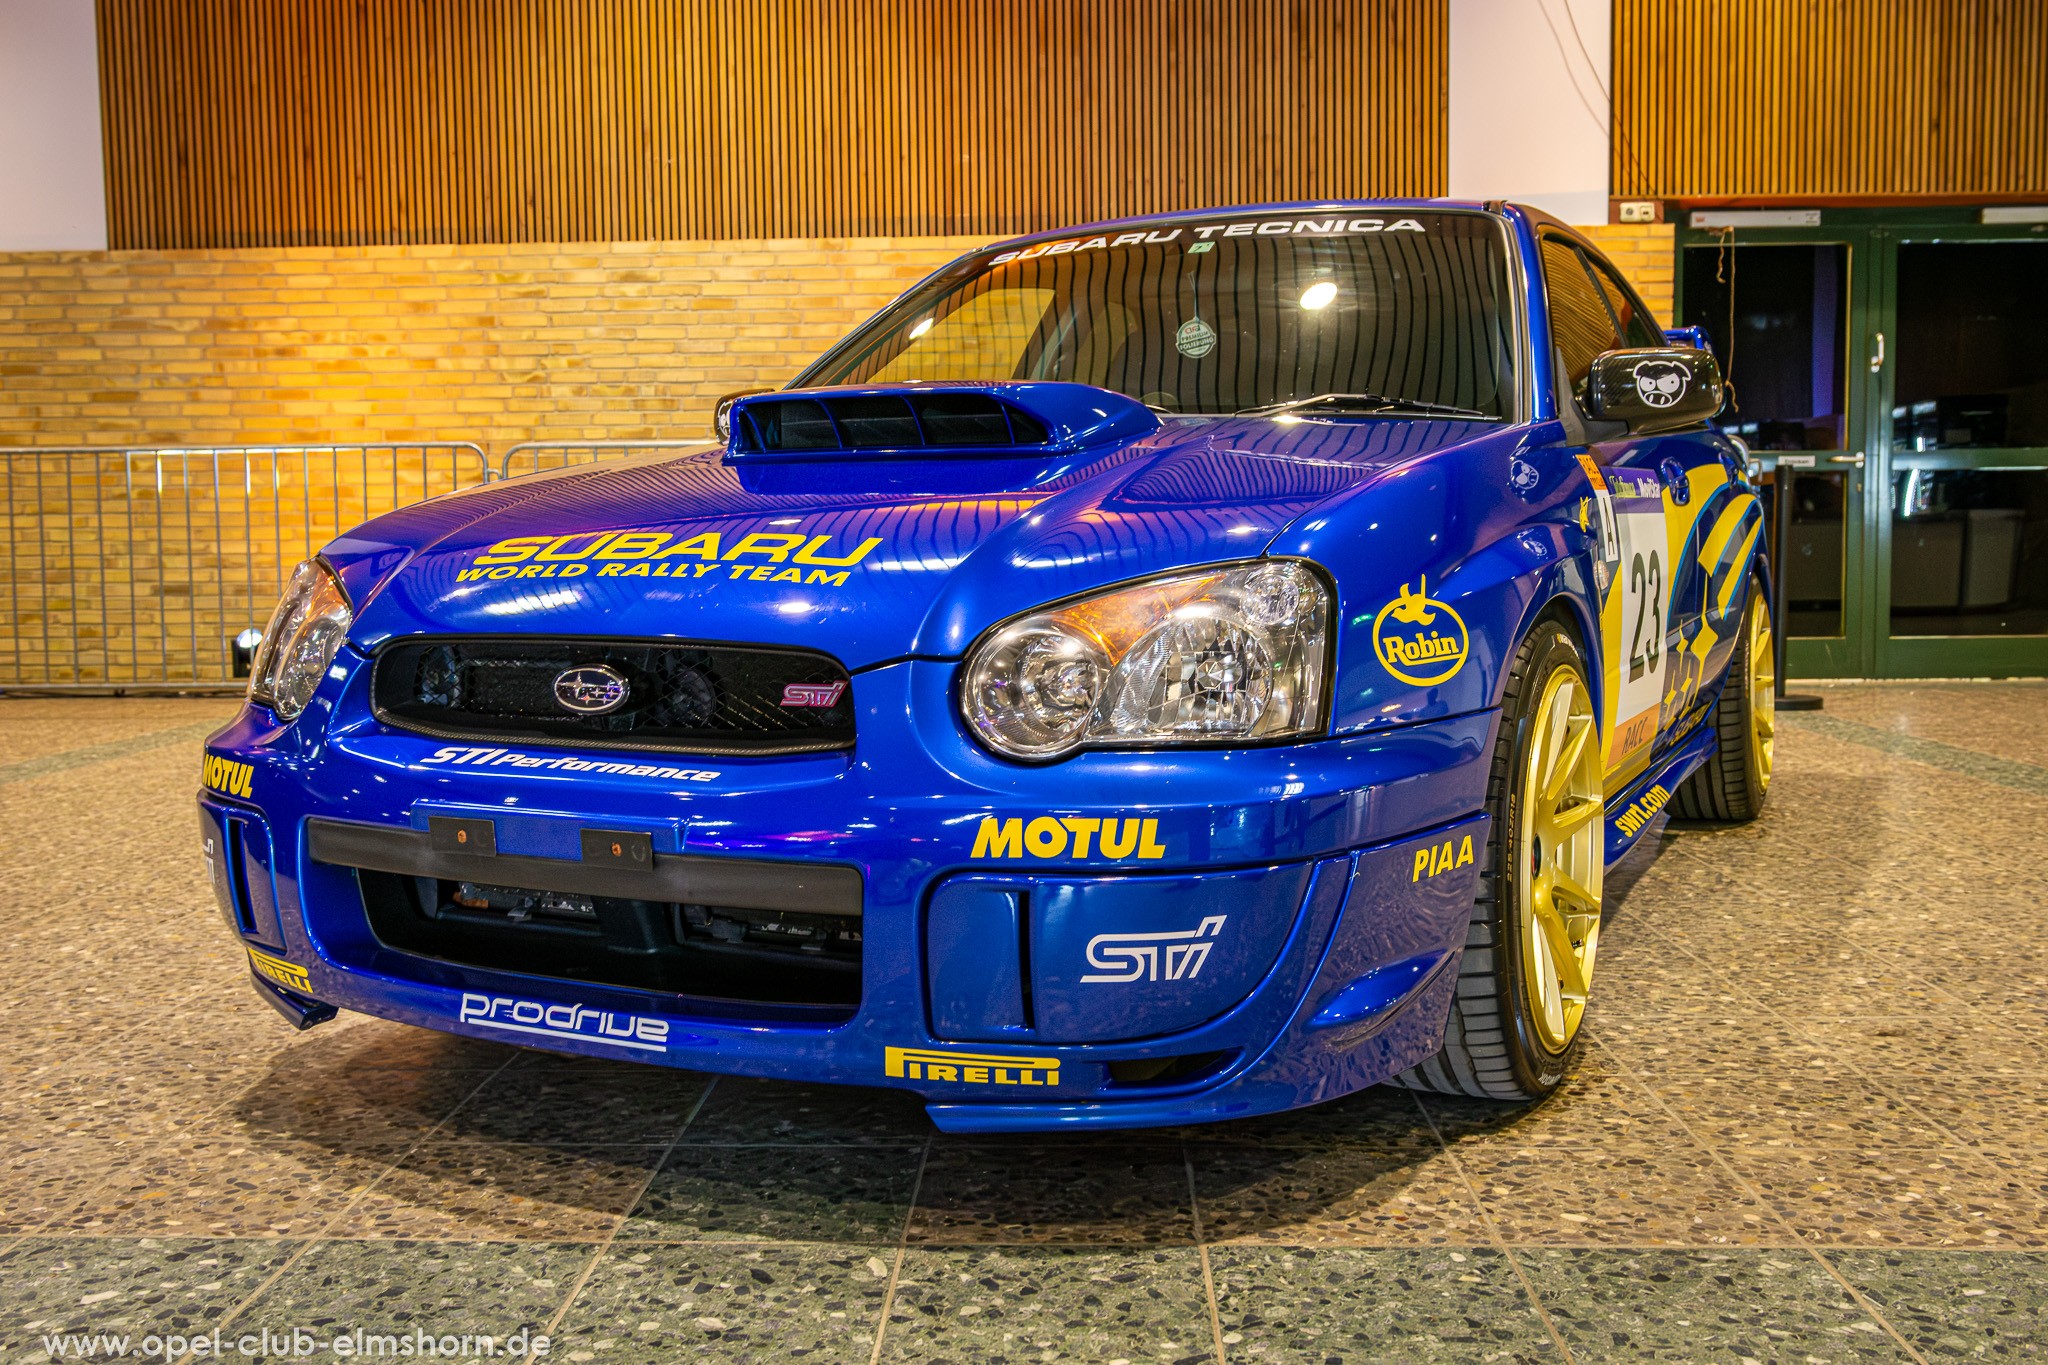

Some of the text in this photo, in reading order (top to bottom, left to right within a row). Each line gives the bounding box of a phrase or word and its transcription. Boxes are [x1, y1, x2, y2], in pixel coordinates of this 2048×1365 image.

[989, 218, 1426, 267] SUBARU TECNICA
[473, 532, 883, 567] SUBARU
[455, 562, 851, 587] WORLD RALLY TEAM
[1629, 550, 1661, 684] 23
[1382, 630, 1459, 664] Robin
[202, 754, 255, 799] MOTUL
[489, 754, 721, 782] Performance
[1614, 784, 1671, 838] swrt.com
[970, 816, 1166, 859] MOTUL
[1412, 834, 1474, 883] PIAA
[247, 947, 314, 994] PIRELLI
[460, 992, 670, 1044] prodrive
[885, 1046, 1061, 1086] PIRELLI
